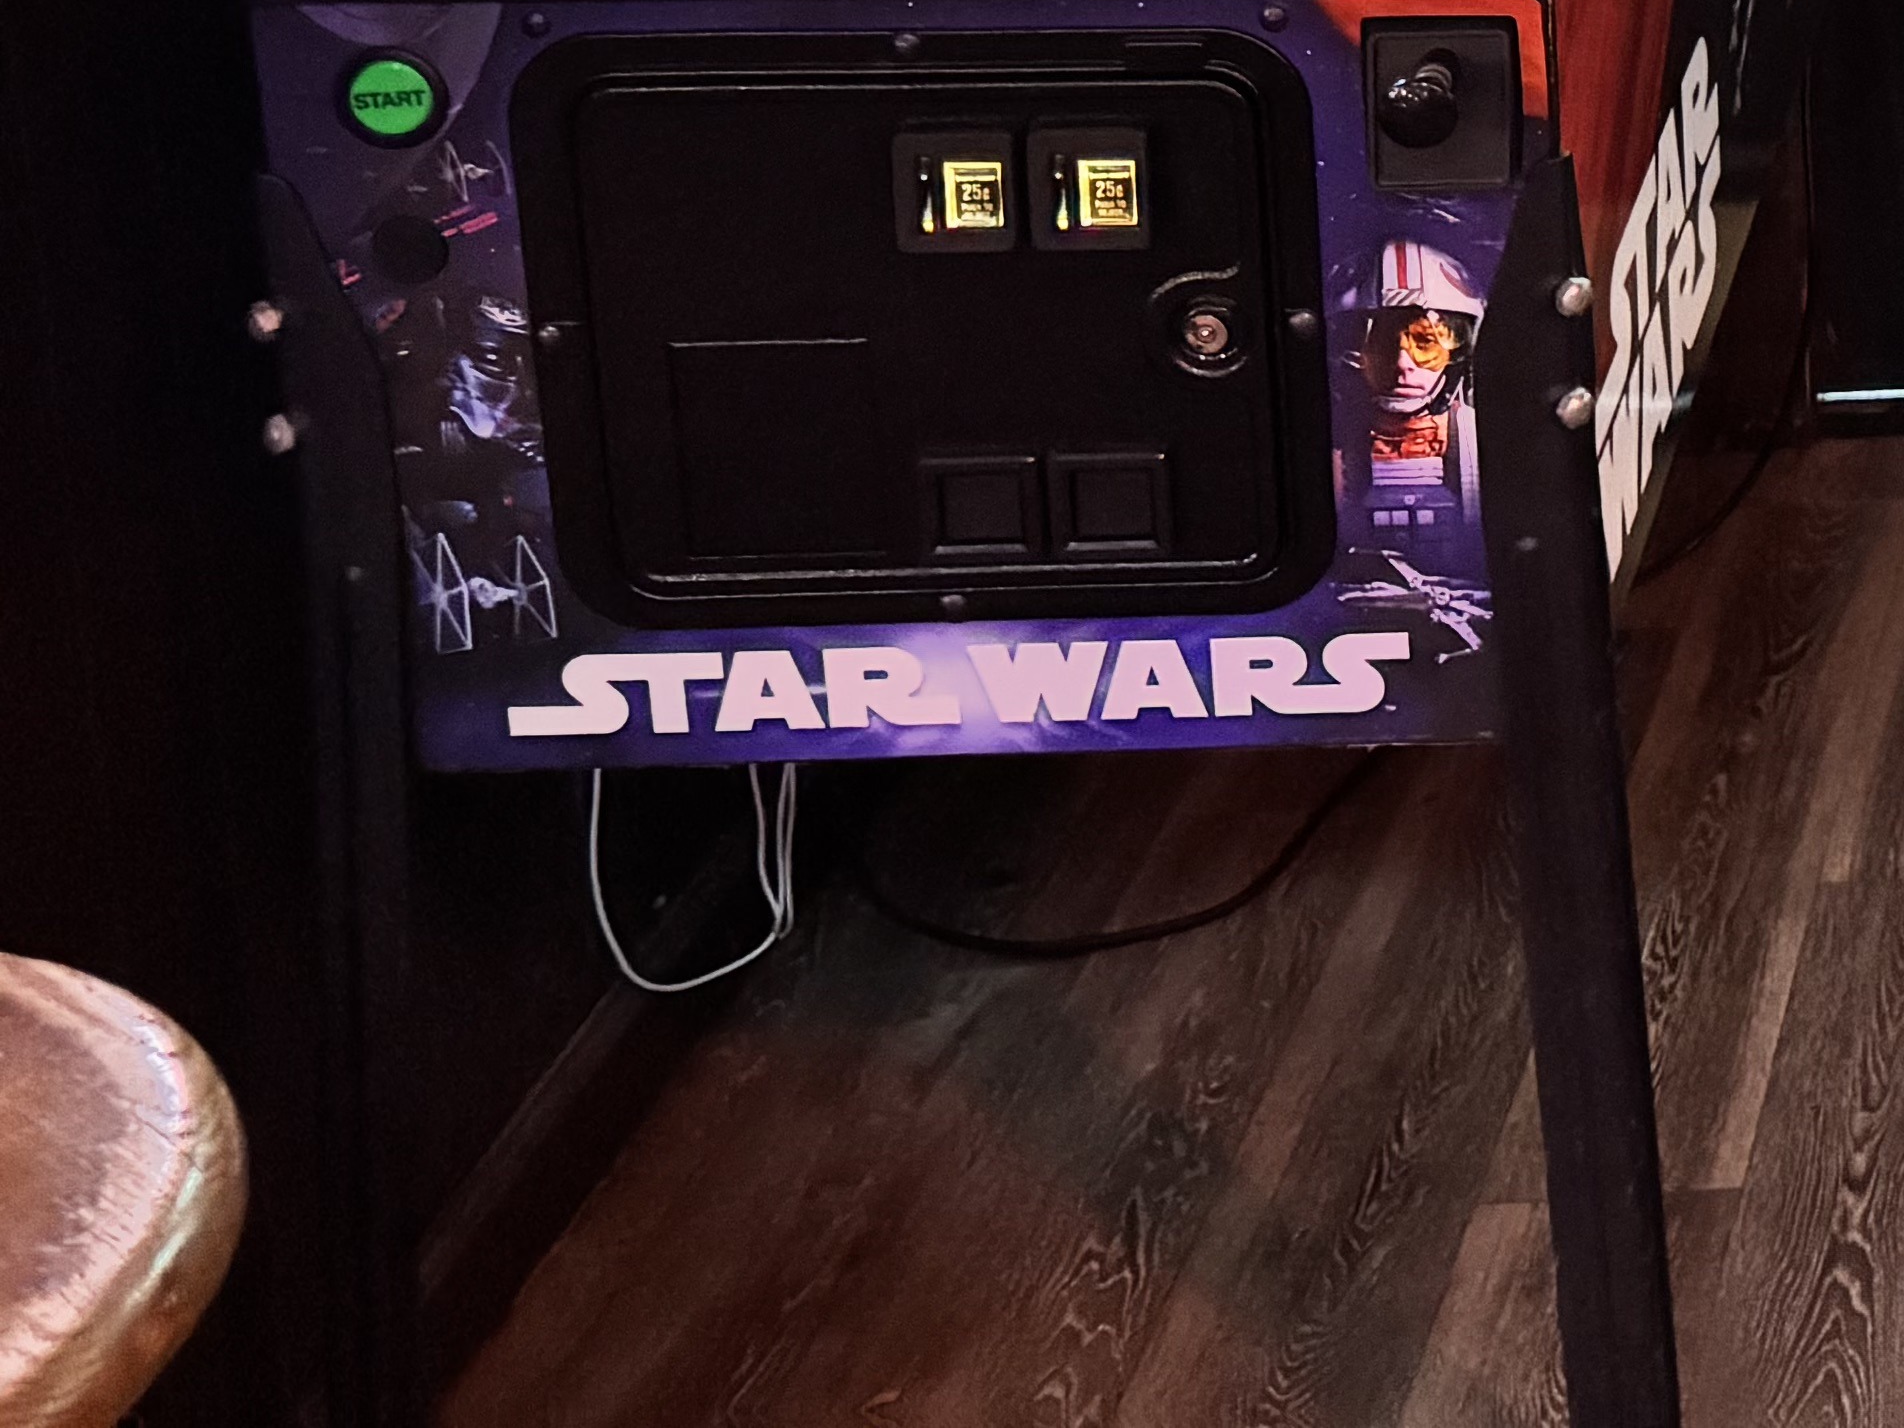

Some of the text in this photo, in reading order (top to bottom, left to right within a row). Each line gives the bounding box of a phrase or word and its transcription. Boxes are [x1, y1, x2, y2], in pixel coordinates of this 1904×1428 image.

[352, 87, 426, 110] START
[961, 183, 990, 201] 25¢
[1095, 180, 1124, 198] 25¢
[508, 631, 1411, 738] STAR WARS
